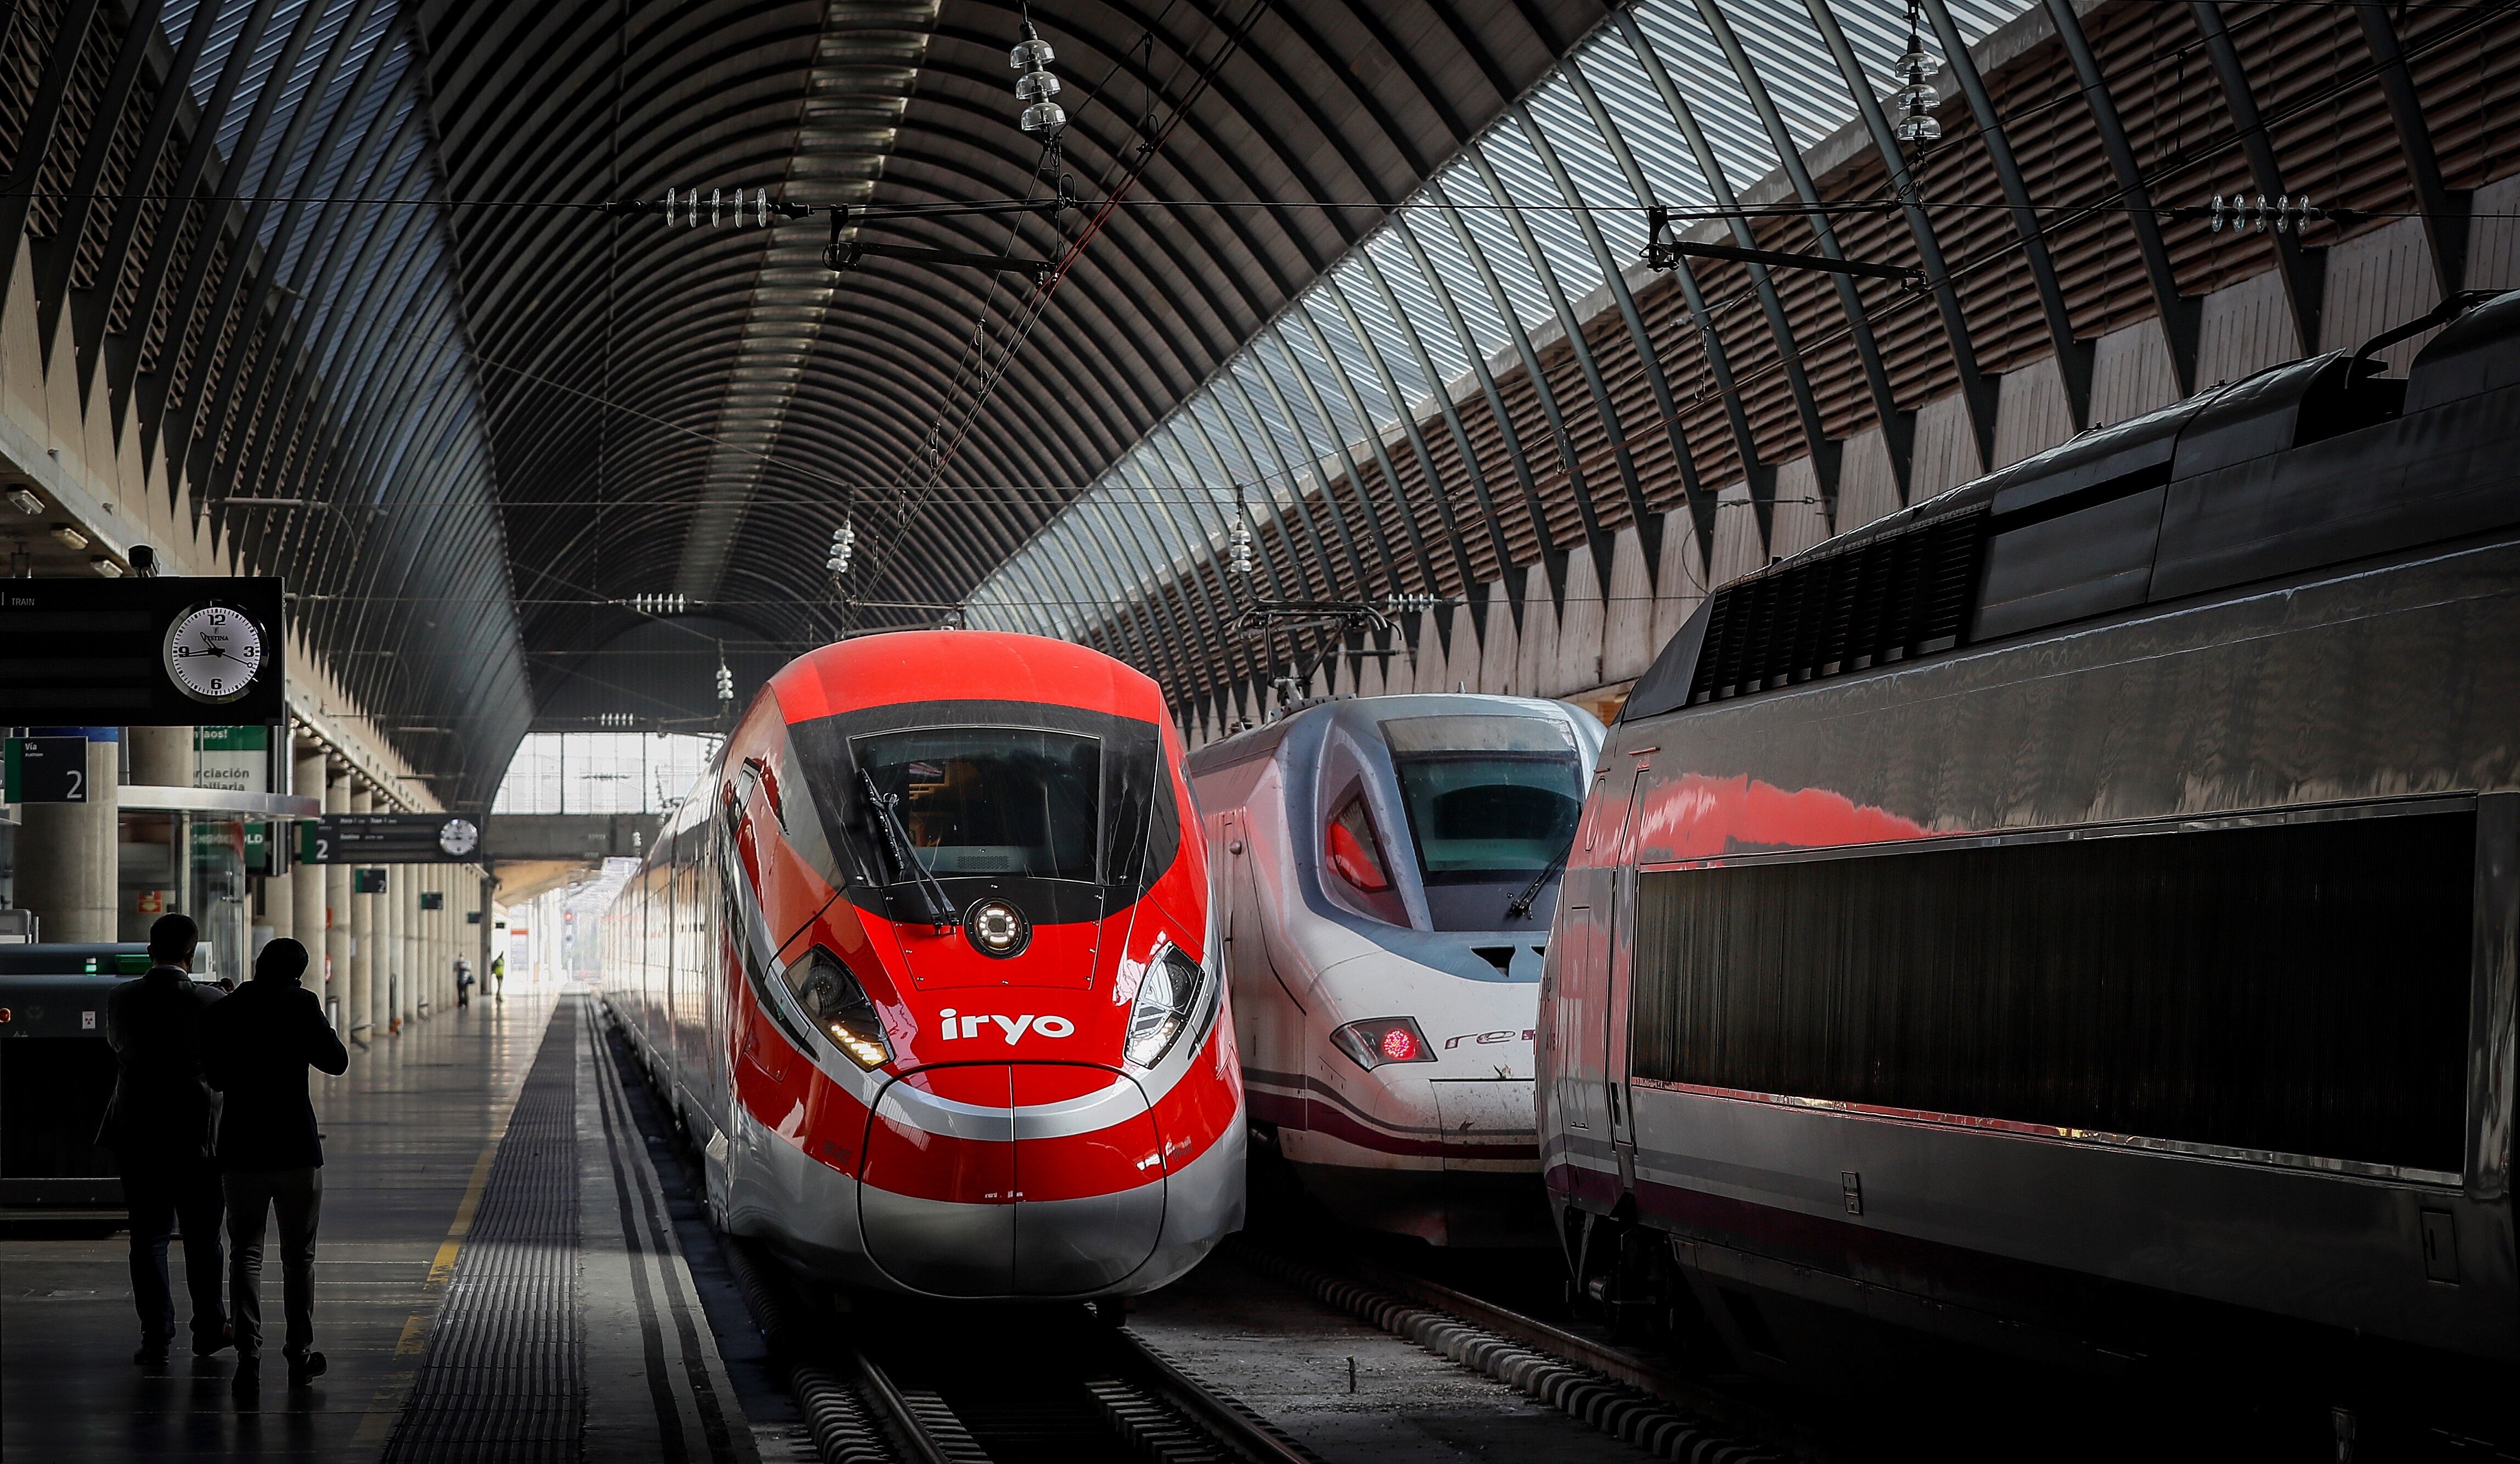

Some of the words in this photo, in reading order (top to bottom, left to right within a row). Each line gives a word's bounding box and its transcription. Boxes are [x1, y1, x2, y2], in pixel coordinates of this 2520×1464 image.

[11, 598, 35, 606] TRAIN
[207, 614, 226, 626] 12
[178, 646, 190, 658] 9
[244, 646, 254, 657] 3
[211, 678, 222, 689] 6
[25, 742, 37, 750] Vía
[66, 770, 82, 799] 2
[316, 839, 329, 860] 2
[940, 1008, 1075, 1046] iryo
